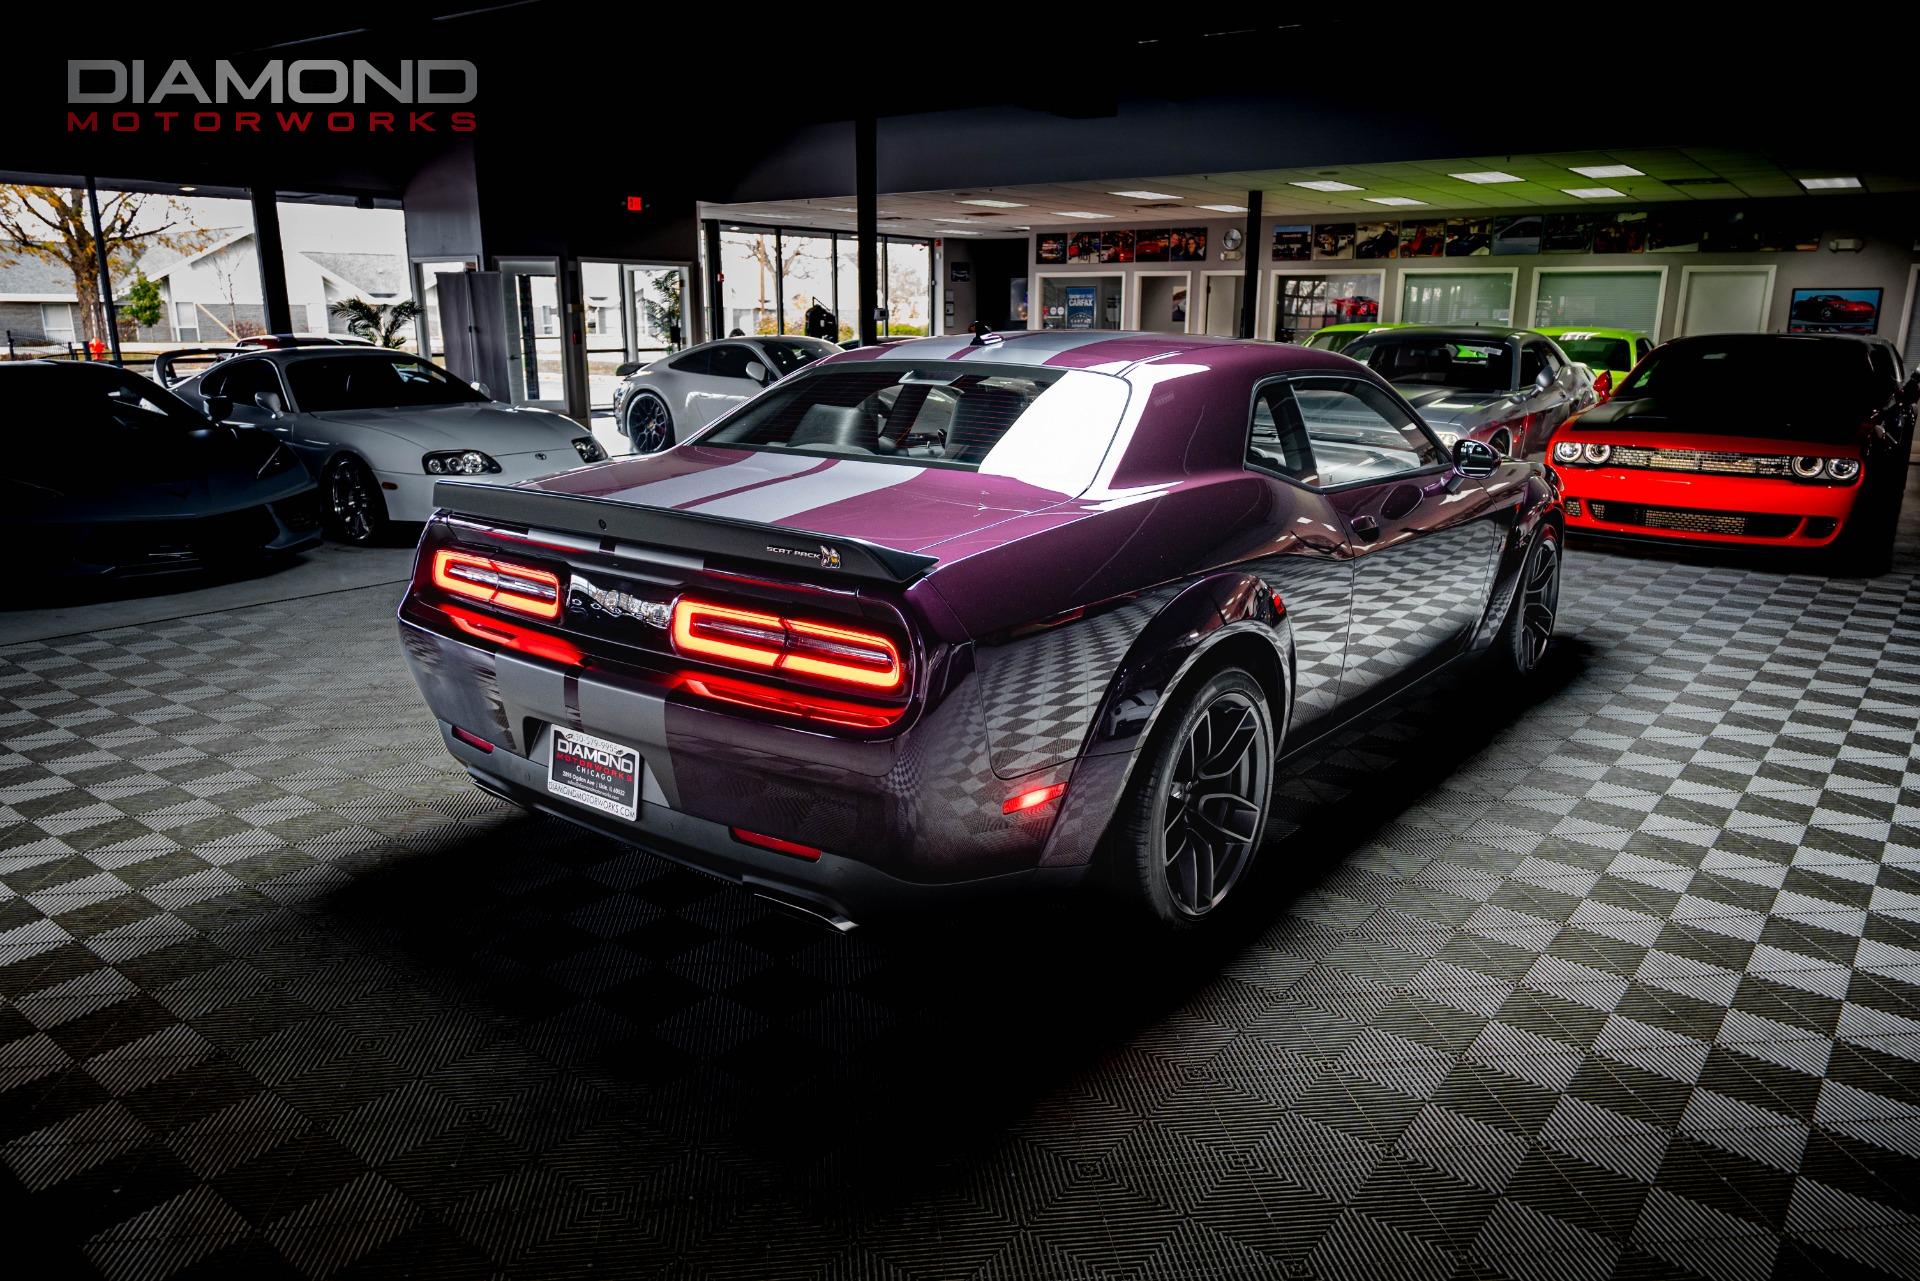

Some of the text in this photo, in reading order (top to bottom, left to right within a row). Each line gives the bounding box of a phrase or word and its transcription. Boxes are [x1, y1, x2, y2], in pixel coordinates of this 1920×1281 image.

[1068, 298, 1093, 307] CARFAX
[766, 546, 821, 559] SCAT PACK
[557, 738, 634, 774] DIAMOND
[556, 751, 633, 782] MOTORWORKS
[576, 765, 612, 782] CHICAGO
